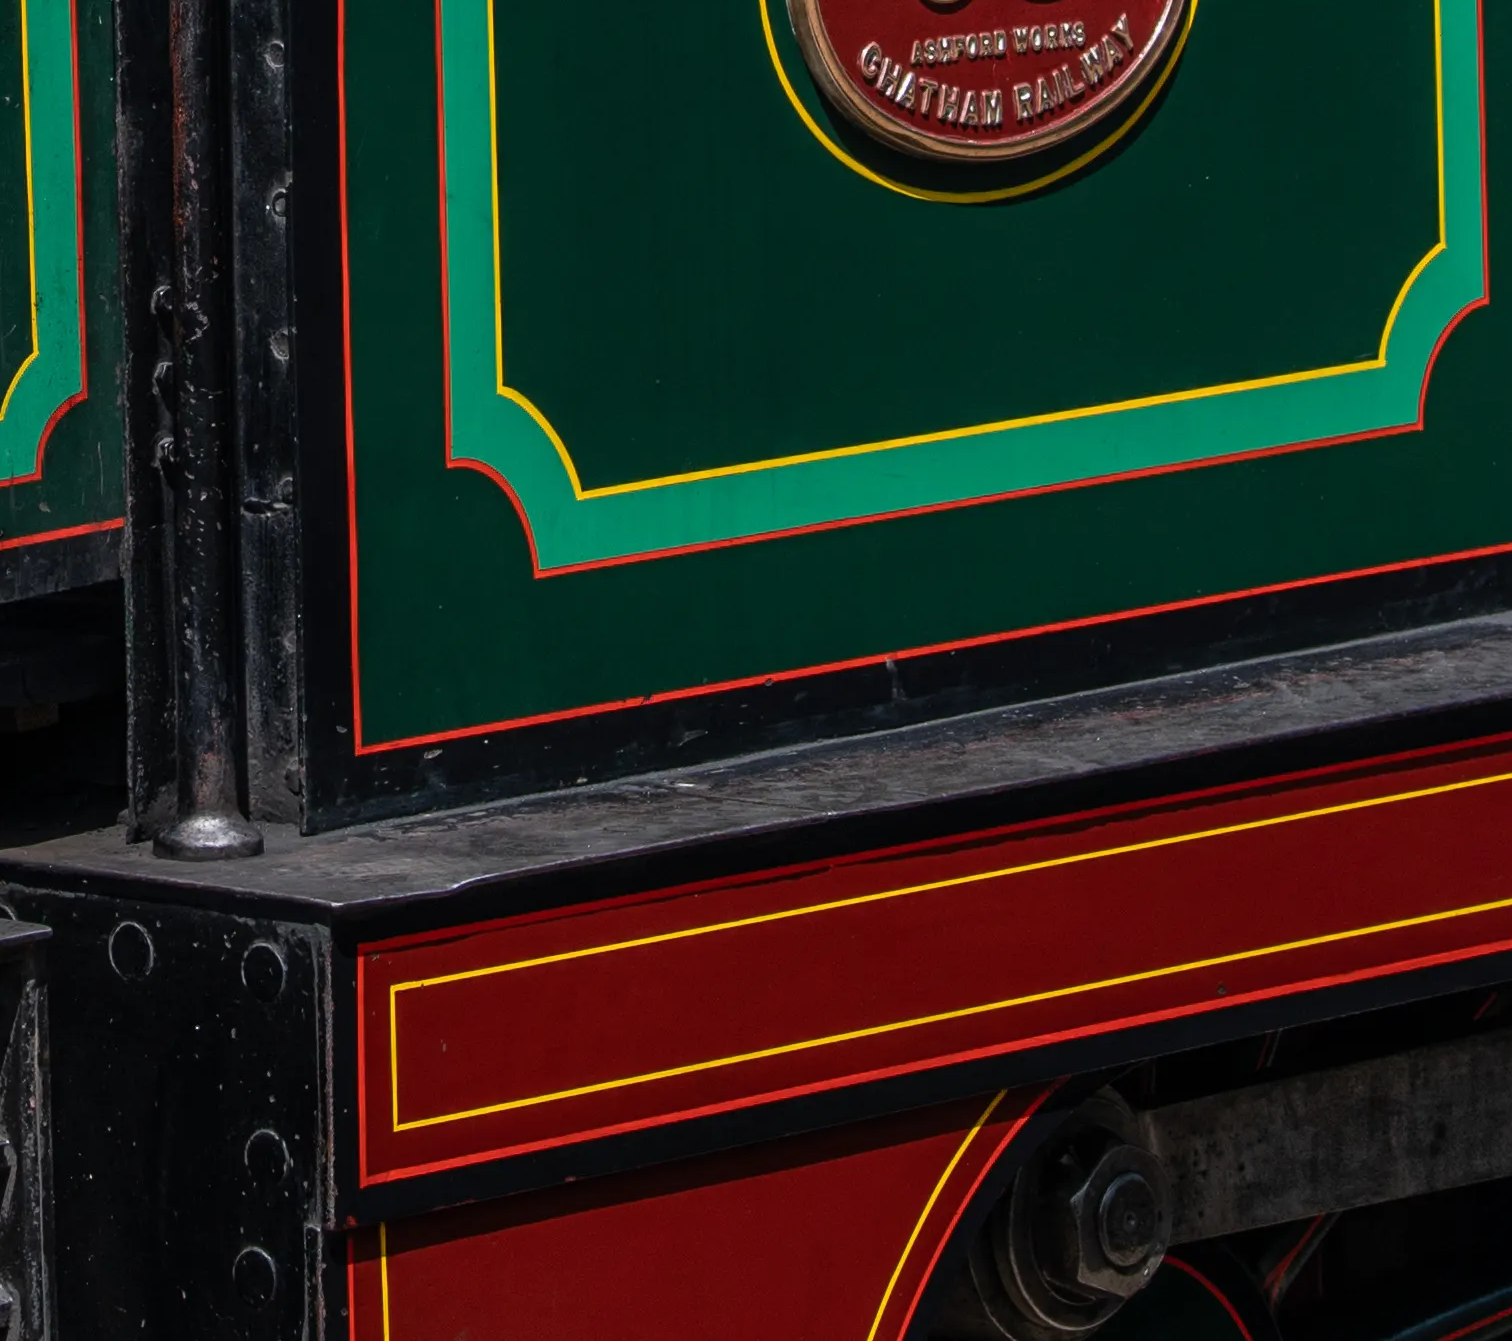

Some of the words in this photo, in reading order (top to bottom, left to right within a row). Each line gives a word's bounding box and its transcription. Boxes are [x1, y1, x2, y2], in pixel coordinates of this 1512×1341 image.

[856, 40, 1004, 128] CHATHAM
[1012, 12, 1135, 125] RAILWAY
[910, 28, 1008, 67] ASHFORD
[1011, 20, 1087, 54] WORKS
